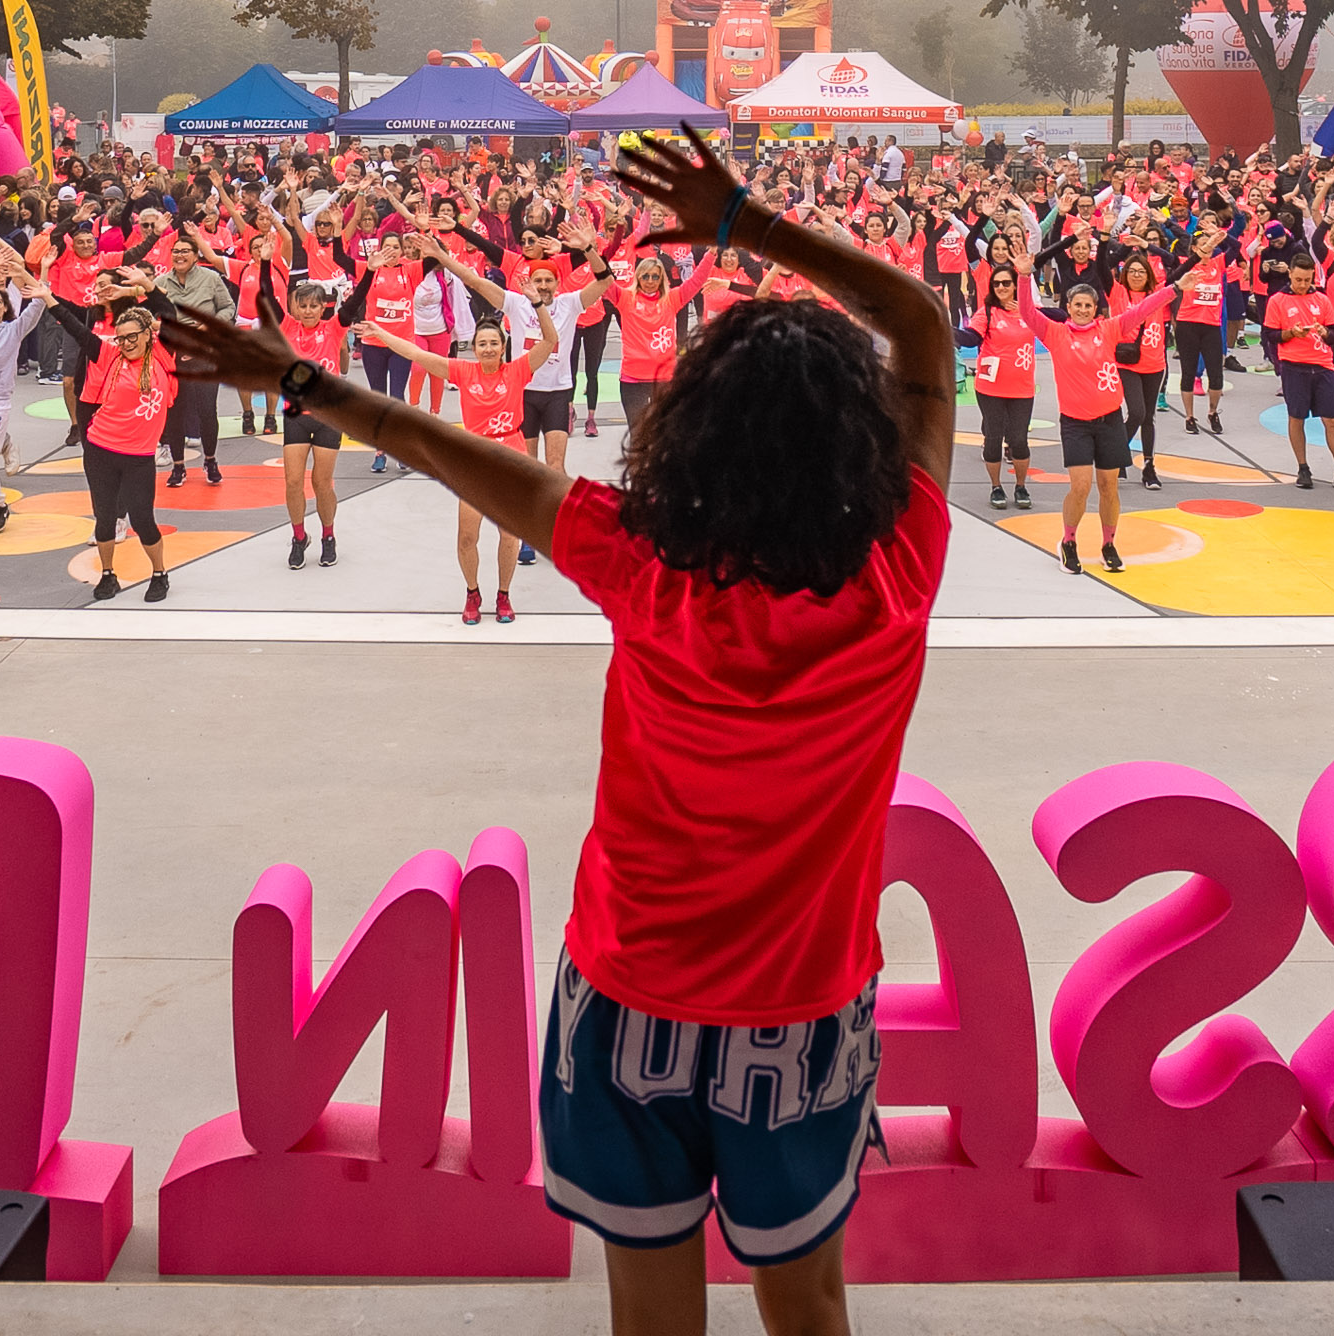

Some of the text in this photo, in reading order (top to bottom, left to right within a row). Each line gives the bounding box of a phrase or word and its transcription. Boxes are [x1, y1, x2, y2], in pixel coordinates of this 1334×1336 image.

[1172, 43, 1214, 59] sangue
[1191, 54, 1216, 69] vita
[820, 84, 869, 94] FIDAS
[768, 106, 927, 119] Donatori Volontari Sangue
[178, 119, 229, 130] COMUNE
[243, 119, 309, 130] MOZZECANE
[385, 119, 436, 129] COMUNE
[450, 119, 516, 130] MOZZECANE
[1198, 292, 1214, 301] 291
[383, 309, 396, 318] 78
